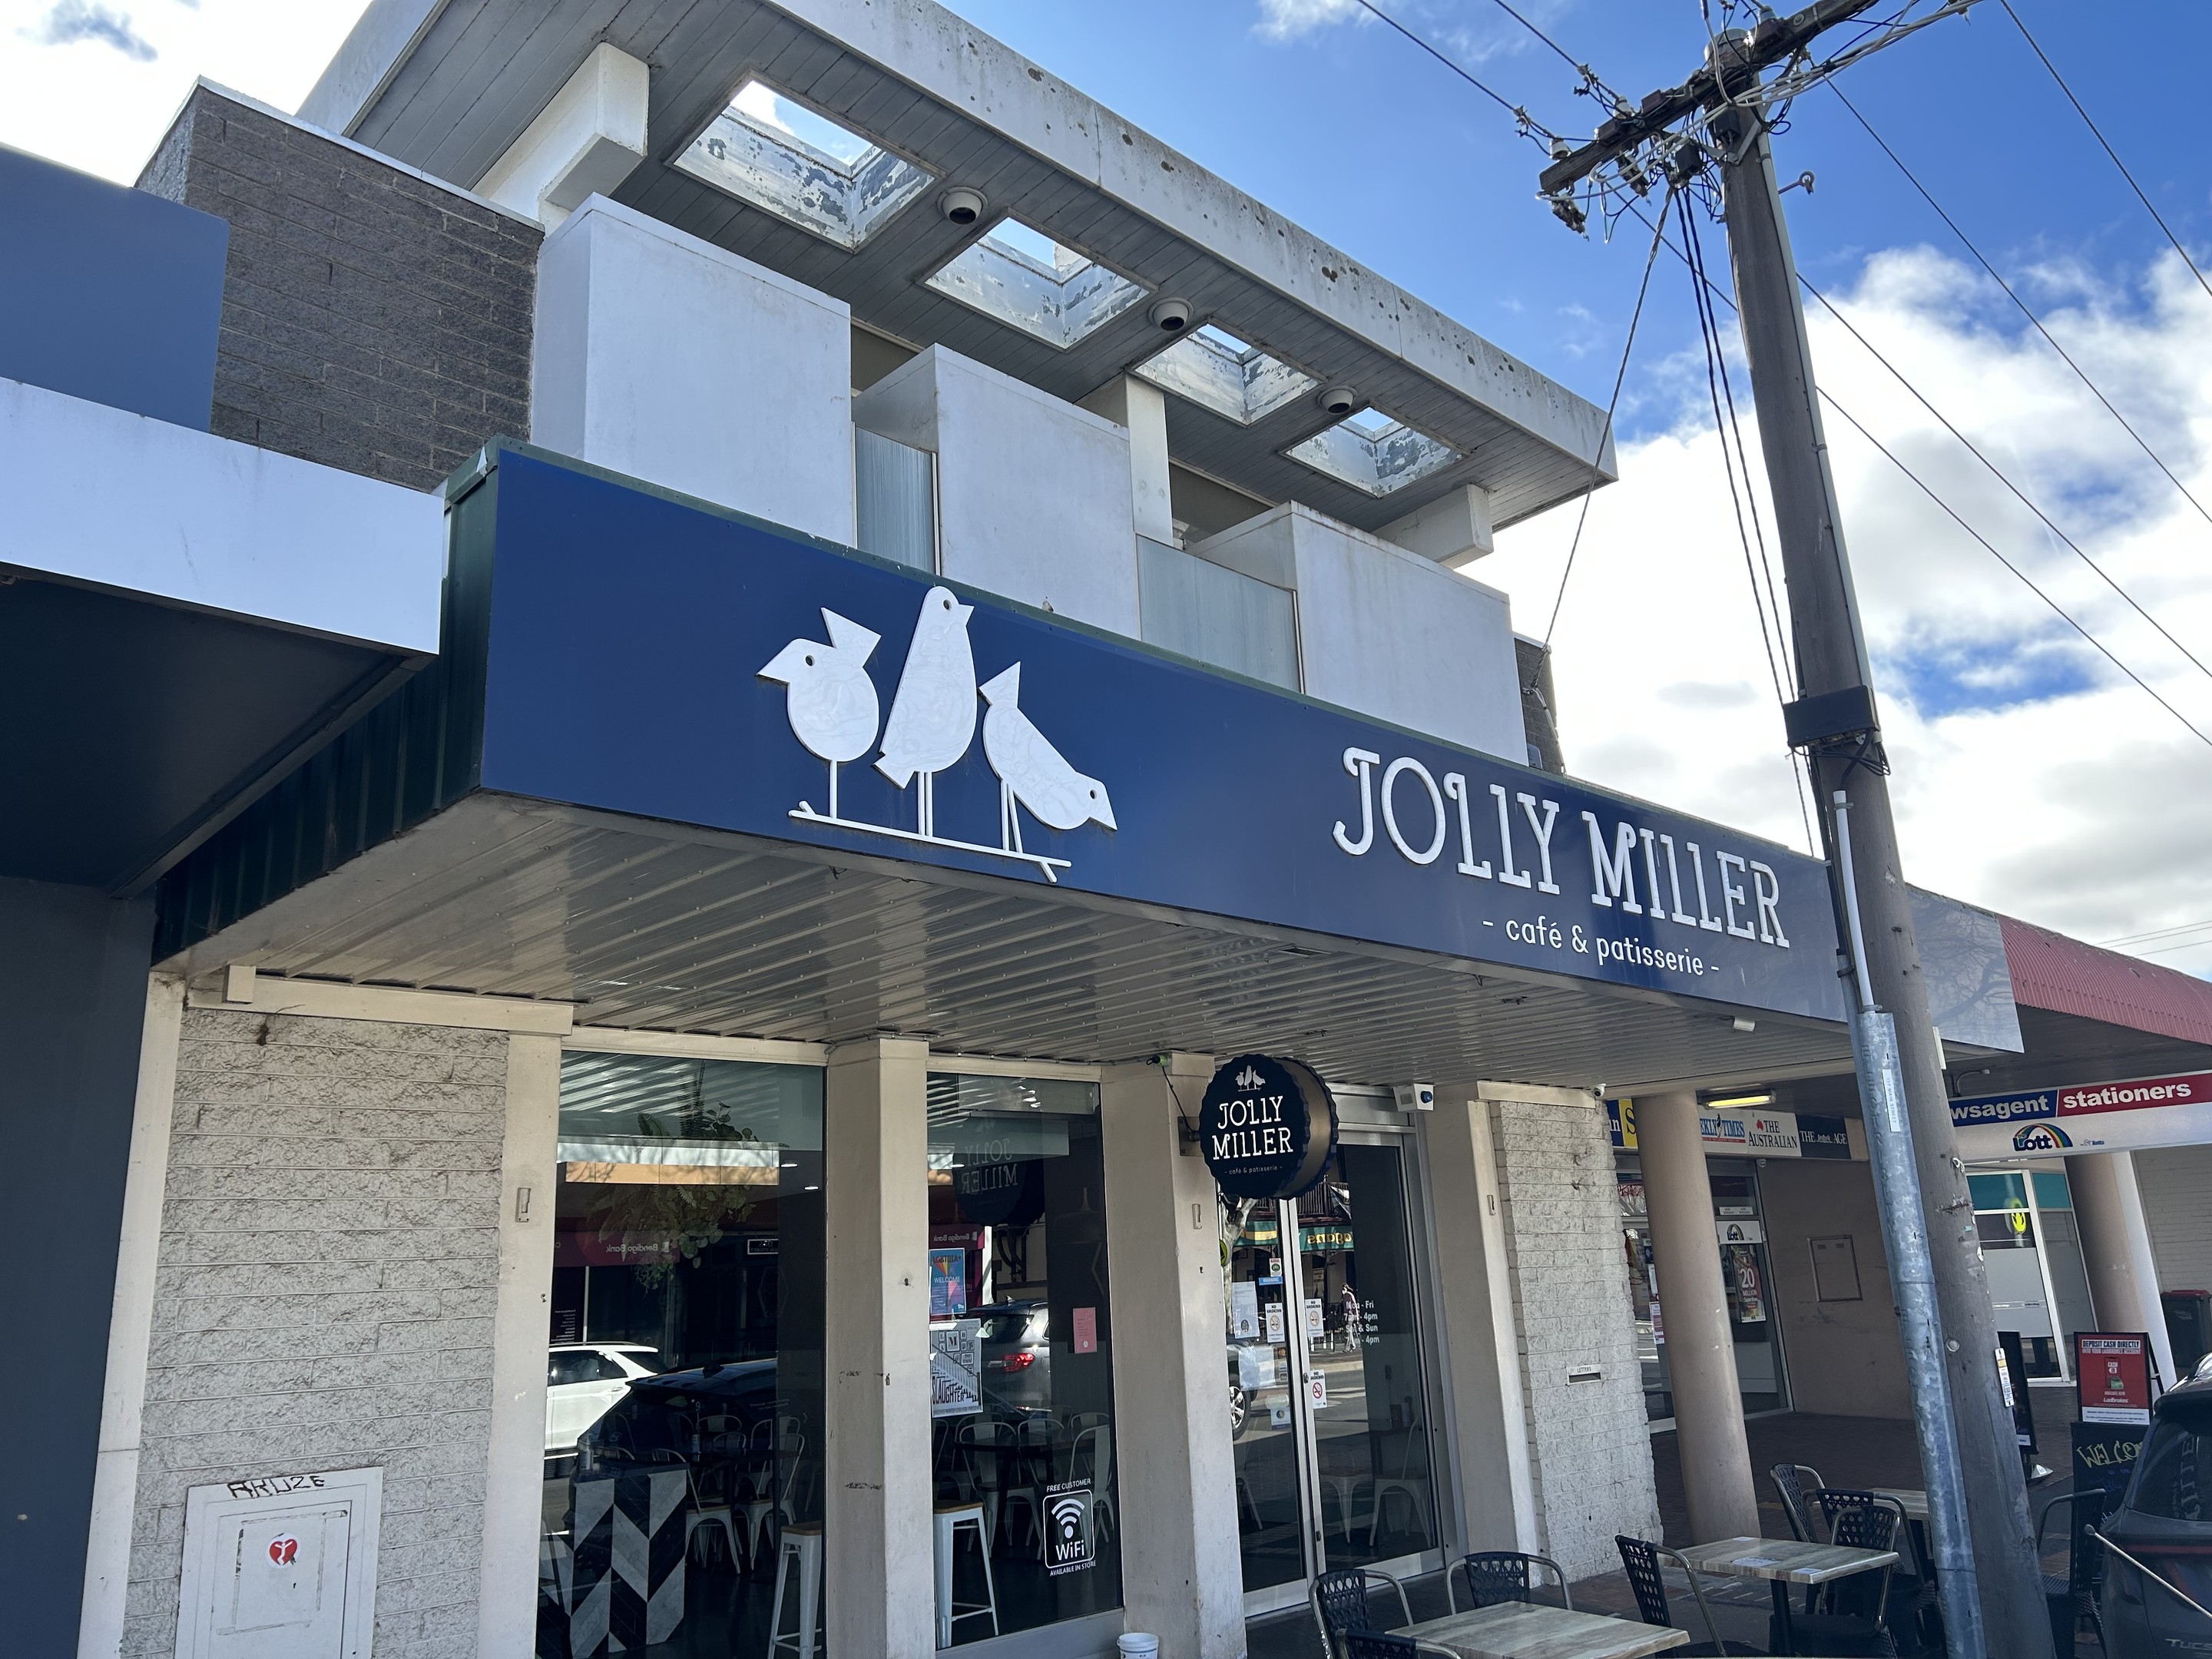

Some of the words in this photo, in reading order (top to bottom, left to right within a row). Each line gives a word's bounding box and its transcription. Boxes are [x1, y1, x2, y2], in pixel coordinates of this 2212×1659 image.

[1333, 747, 1560, 895] JOLLY
[1581, 810, 1790, 948] MILLER
[1505, 915, 1562, 949] café
[1571, 924, 1589, 954] &
[1597, 935, 1704, 976] patisserie
[2063, 1083, 2192, 1109] stationers
[1217, 1095, 1283, 1130] JOLLY
[1950, 1094, 2050, 1121] wsagent
[1721, 1119, 1745, 1138] TIMES
[1763, 1120, 1780, 1134] THE
[1212, 1127, 1293, 1161] MILLER
[1748, 1131, 1798, 1148] AUSTRALIAN
[1800, 1131, 1816, 1143] THE
[1833, 1132, 1848, 1144] AGE
[1249, 1165, 1278, 1174] patisserie
[1365, 1300, 1374, 1309] Fri
[1363, 1312, 1378, 1322] 4pm
[1366, 1323, 1379, 1332] Sun
[1365, 1335, 1380, 1346] 4pm
[932, 1376, 965, 1405] SLAUGHTER
[1046, 1482, 1061, 1492] FREE
[1061, 1478, 1091, 1490] CUSTOMER
[1055, 1539, 1084, 1561] WiFi
[1049, 1565, 1075, 1577] AVAILABLE
[1075, 1563, 1081, 1571] IN
[1081, 1560, 1097, 1569] STORE
